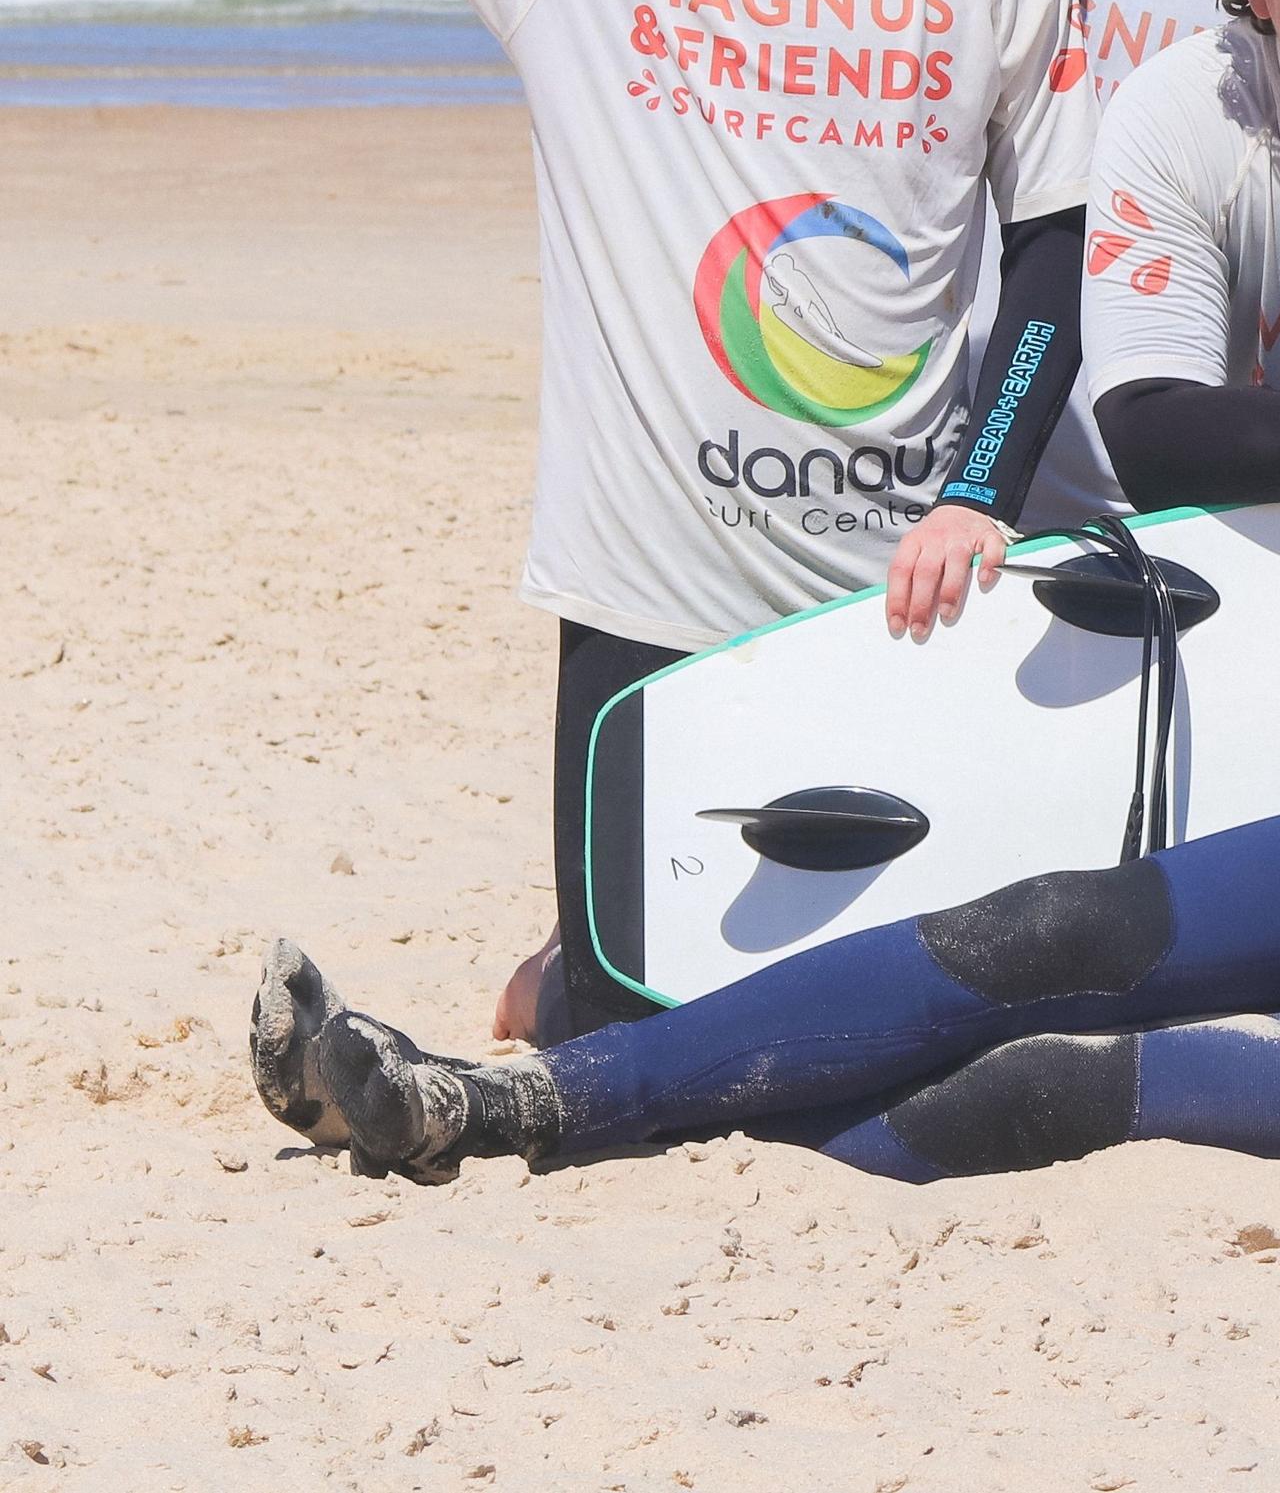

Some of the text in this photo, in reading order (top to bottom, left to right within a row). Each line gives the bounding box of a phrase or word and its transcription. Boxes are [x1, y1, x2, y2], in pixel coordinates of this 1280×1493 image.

[672, 85, 915, 149] SURFCAMP
[963, 320, 1056, 484] OCEAN+EARTH
[697, 428, 935, 499] danau
